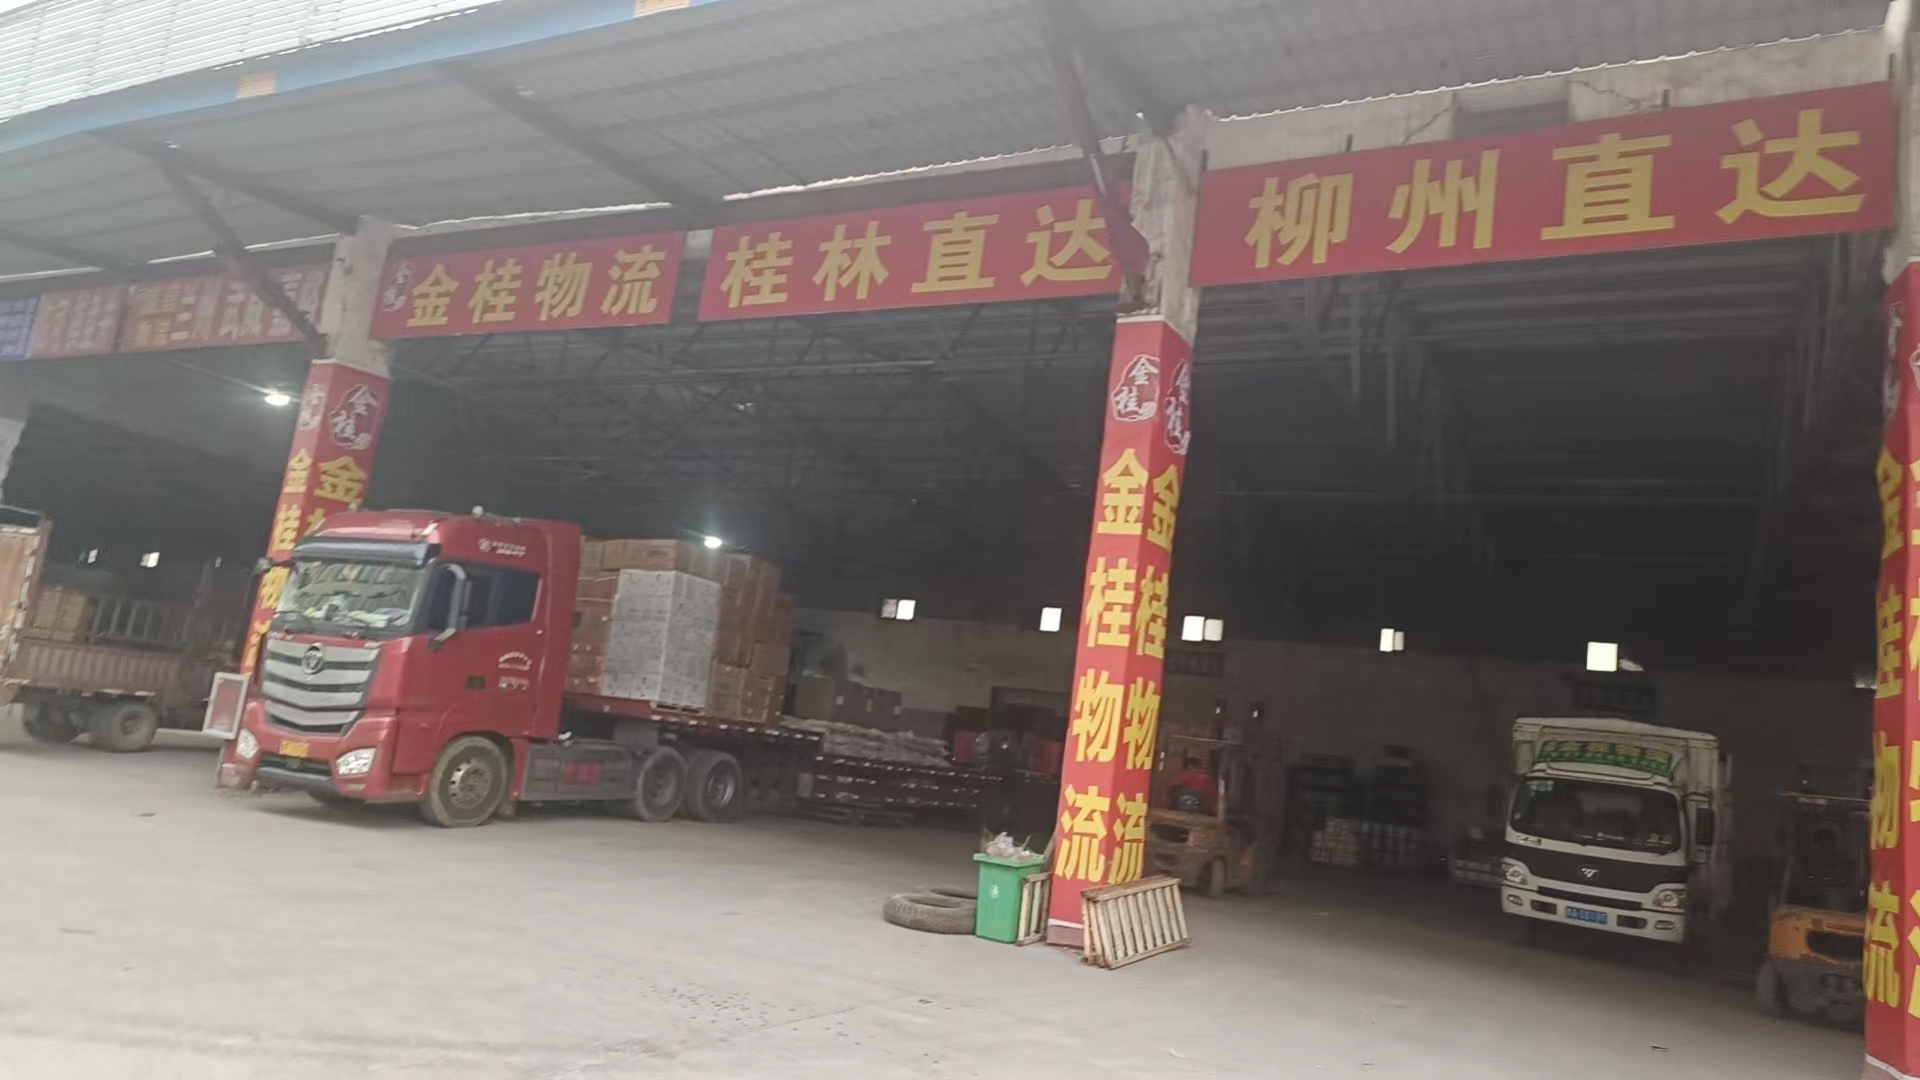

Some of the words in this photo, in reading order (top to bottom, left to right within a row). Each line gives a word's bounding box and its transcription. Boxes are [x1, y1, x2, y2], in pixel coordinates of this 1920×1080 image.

[719, 198, 1114, 309] 桂林直达
[1244, 109, 1867, 268] 柳州直达
[406, 244, 666, 328] 金桂物流
[1054, 448, 1149, 883] 金桂物流
[1108, 464, 1179, 884] 金桂物流
